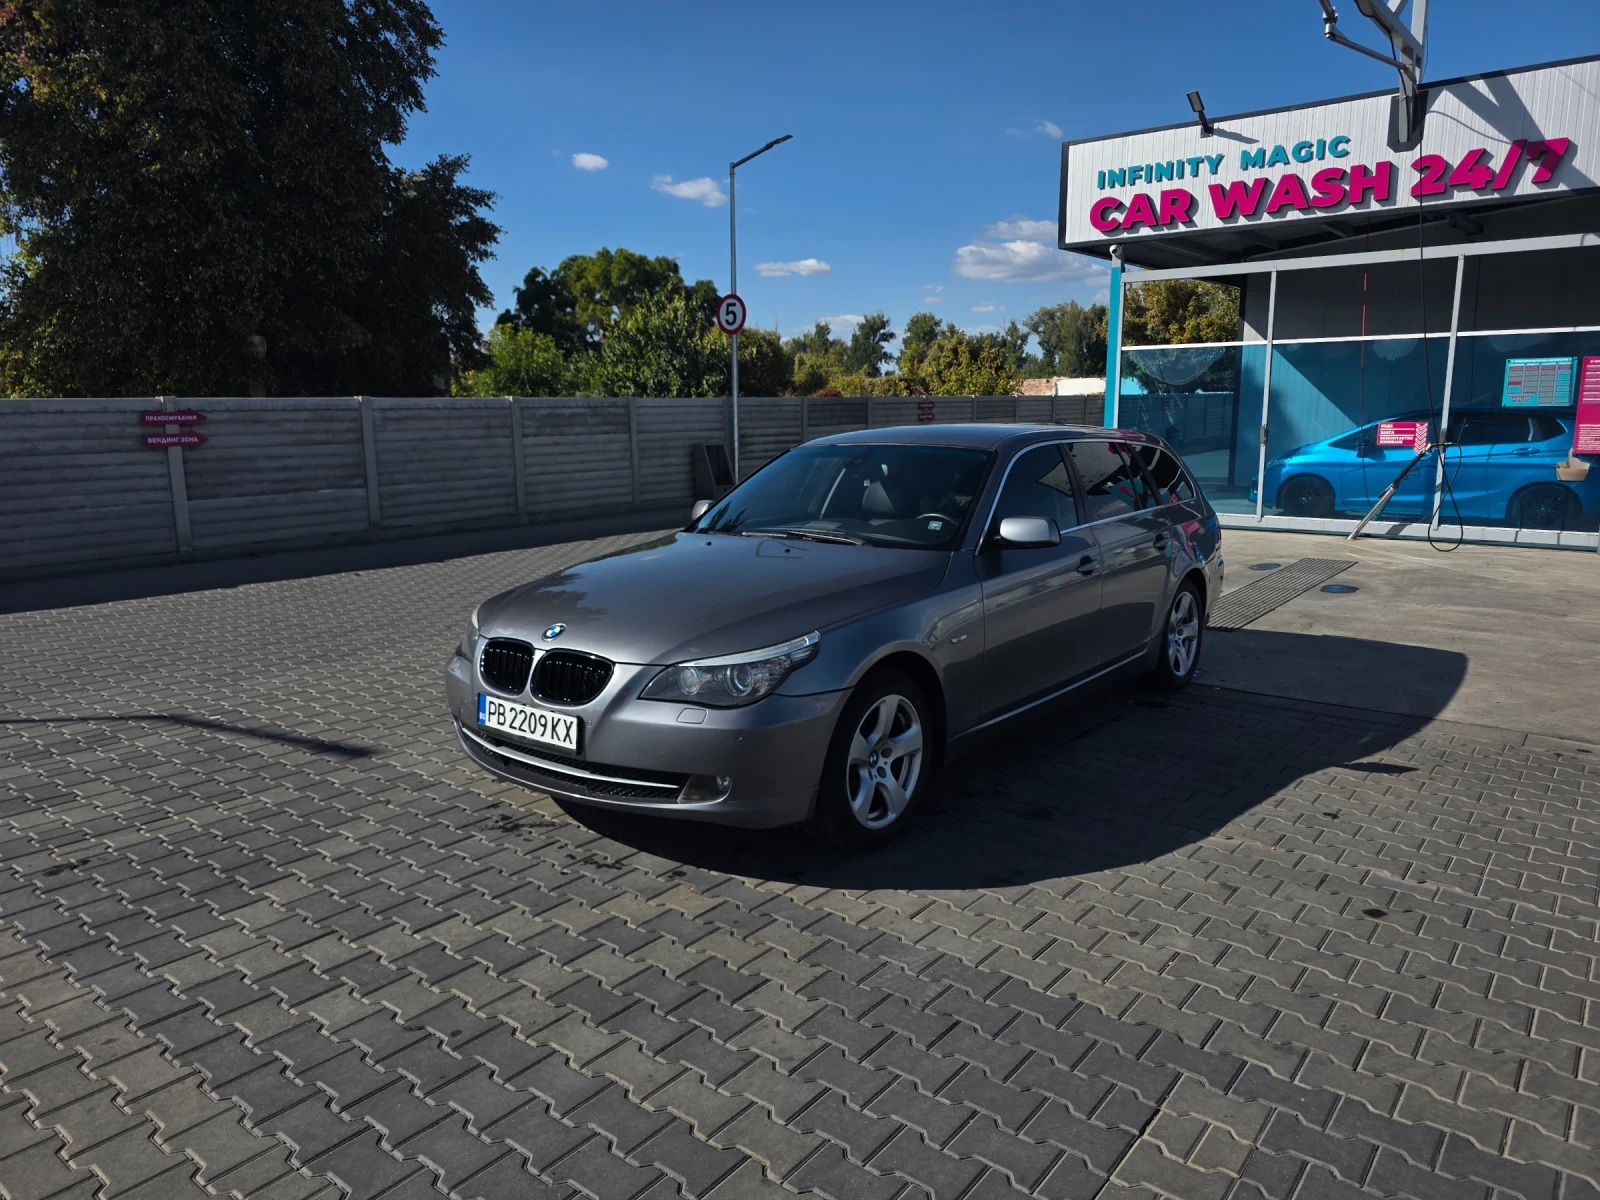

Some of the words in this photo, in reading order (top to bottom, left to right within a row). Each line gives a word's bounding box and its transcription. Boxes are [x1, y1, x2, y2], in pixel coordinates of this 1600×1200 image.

[1089, 188, 1194, 232] CAR
[1208, 161, 1392, 219] WASH
[1410, 137, 1569, 198] 24/7
[1097, 153, 1225, 190] INFINITY
[1239, 135, 1351, 170] MAGIC
[725, 302, 737, 326] 5
